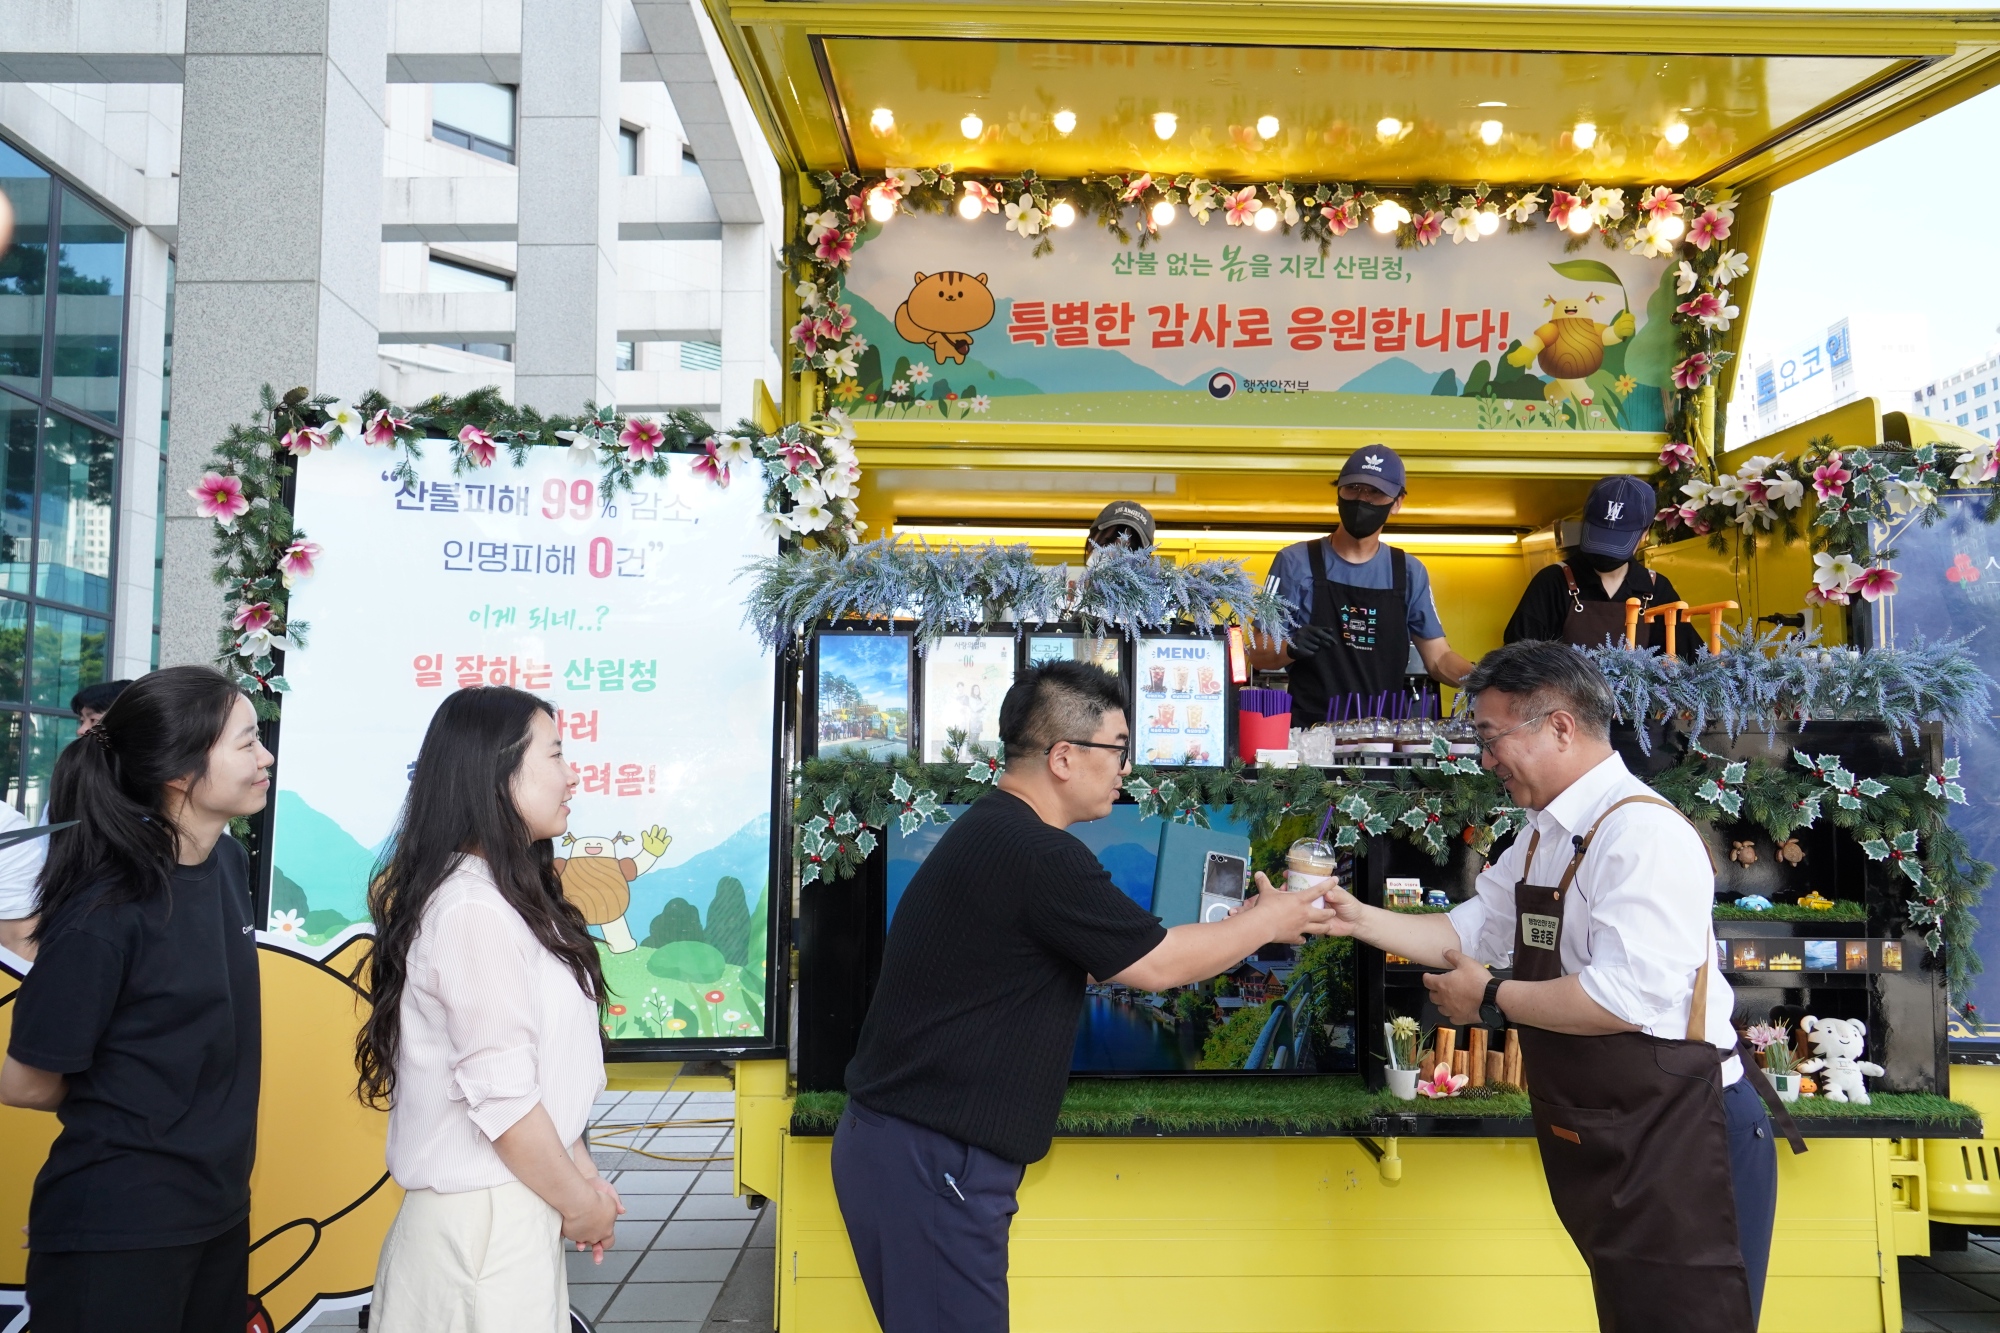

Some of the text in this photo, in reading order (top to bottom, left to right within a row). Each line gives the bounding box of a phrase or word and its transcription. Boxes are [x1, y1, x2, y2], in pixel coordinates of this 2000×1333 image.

[1111, 244, 1413, 284] 산불 없는 봄을 지킨 산림청,
[1006, 300, 1511, 354] 특별한 감사로 응원합니다!
[1242, 377, 1311, 395] 행정안전부
[1756, 326, 1850, 406] 토요코인
[1361, 463, 1382, 473] adidas
[541, 477, 618, 521] 99%
[630, 490, 700, 525] 감소,
[442, 535, 665, 579] 인명피해 0건”
[468, 603, 611, 632] 이게 되네..?
[412, 653, 658, 693] 일 잘하는 산림청
[1156, 646, 1206, 660] MENU
